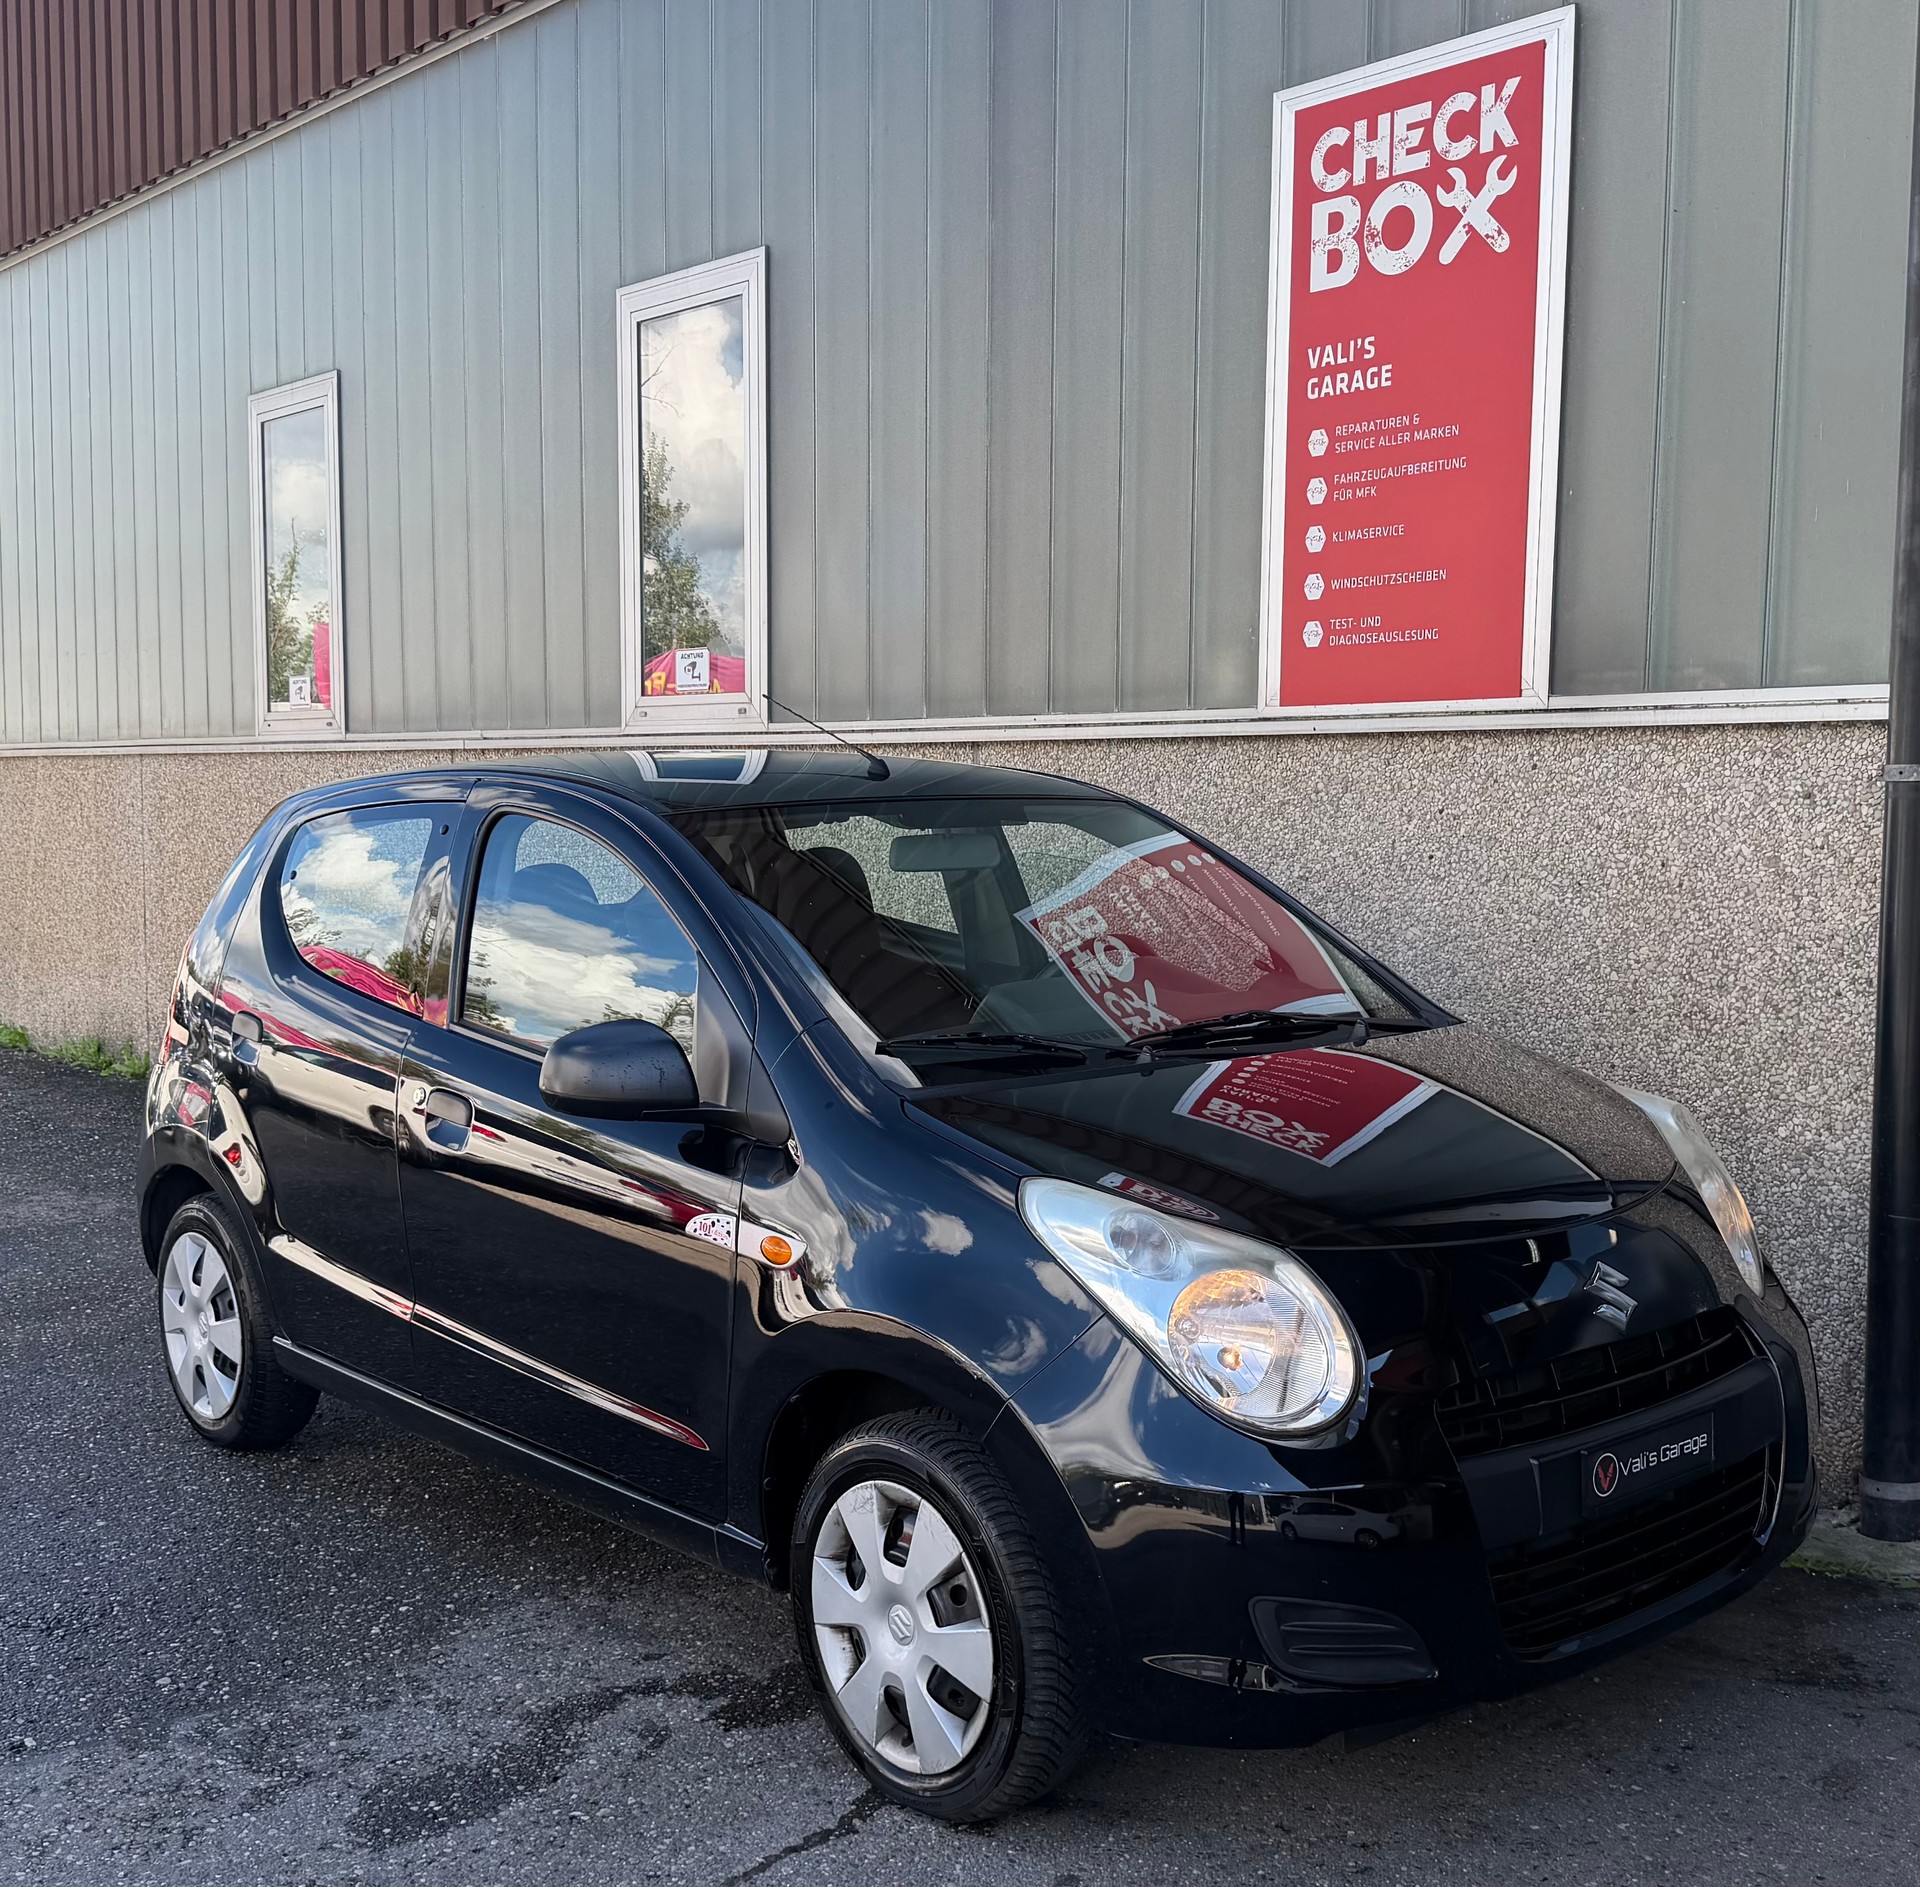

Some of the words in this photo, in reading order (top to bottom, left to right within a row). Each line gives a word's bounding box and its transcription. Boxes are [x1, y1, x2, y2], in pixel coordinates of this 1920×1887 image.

[1310, 75, 1522, 193] CHECK
[1309, 154, 1518, 293] BOX
[1307, 335, 1376, 369] VALI'S
[1306, 363, 1393, 400] GARAGE
[1334, 436, 1376, 454] SERVICE
[1378, 431, 1411, 447] ALLER
[1413, 423, 1460, 442] MARKEN
[1335, 415, 1410, 437] REPARATUREN
[1413, 413, 1421, 425] &
[1333, 456, 1467, 486] FAHRZEUGAUFBEREITUNG
[1333, 488, 1353, 502] FÜR
[1355, 485, 1377, 499] MFK
[1332, 523, 1405, 543] KLIMASERVICE
[1330, 568, 1447, 590] WINDSCHUTZSCHEIBEN
[1329, 617, 1357, 630] TEST-
[1360, 615, 1382, 628] UND
[1329, 627, 1439, 647] DIAGNOSEAUSLESUNG
[699, 1221, 712, 1234] 101
[1620, 1451, 1658, 1476] Vali's
[1660, 1433, 1708, 1462] Garage
